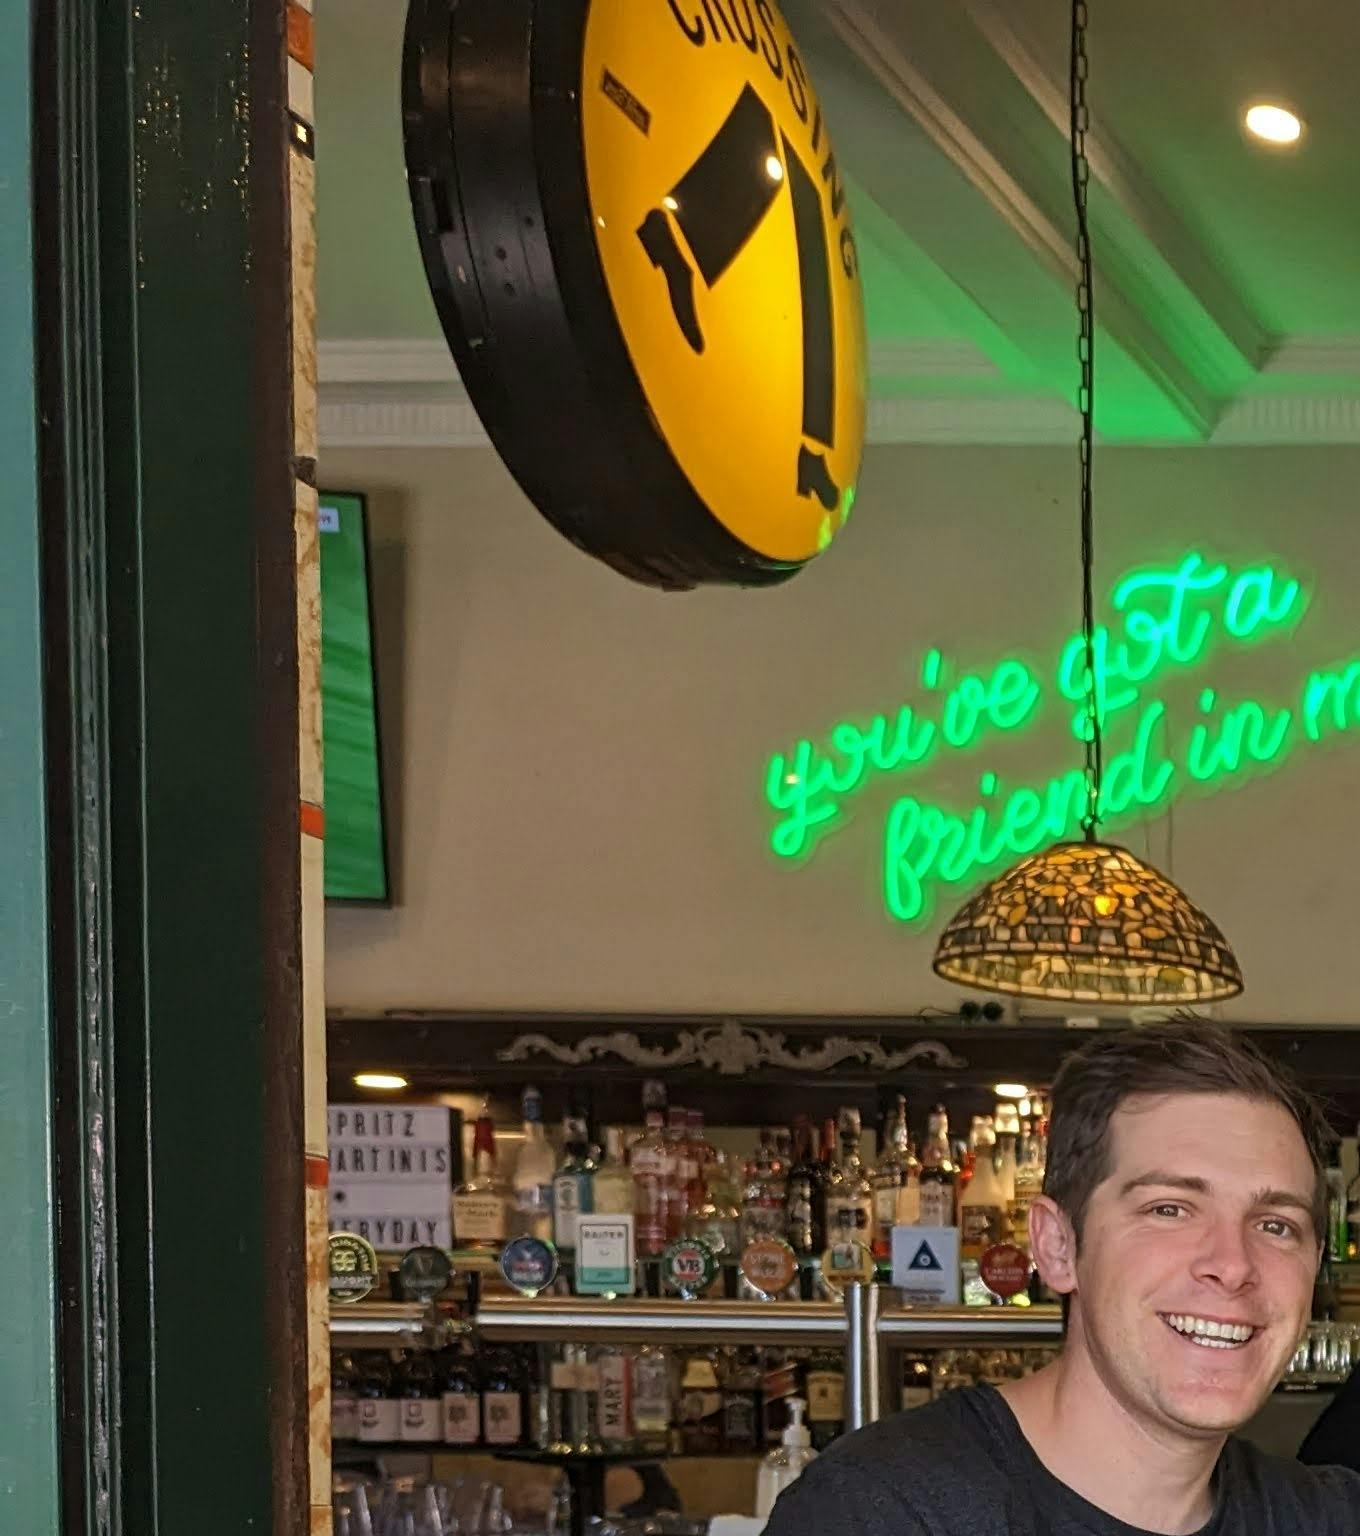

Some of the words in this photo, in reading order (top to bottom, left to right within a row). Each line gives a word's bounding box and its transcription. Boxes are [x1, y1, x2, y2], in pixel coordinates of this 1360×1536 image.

[766, 647, 1041, 859] you've
[1058, 552, 1229, 742] got
[1226, 564, 1300, 638] a
[886, 701, 1175, 920] friend
[1189, 689, 1292, 780] in
[328, 1111, 416, 1137] PRITZ
[328, 1148, 447, 1173] ARTINIS
